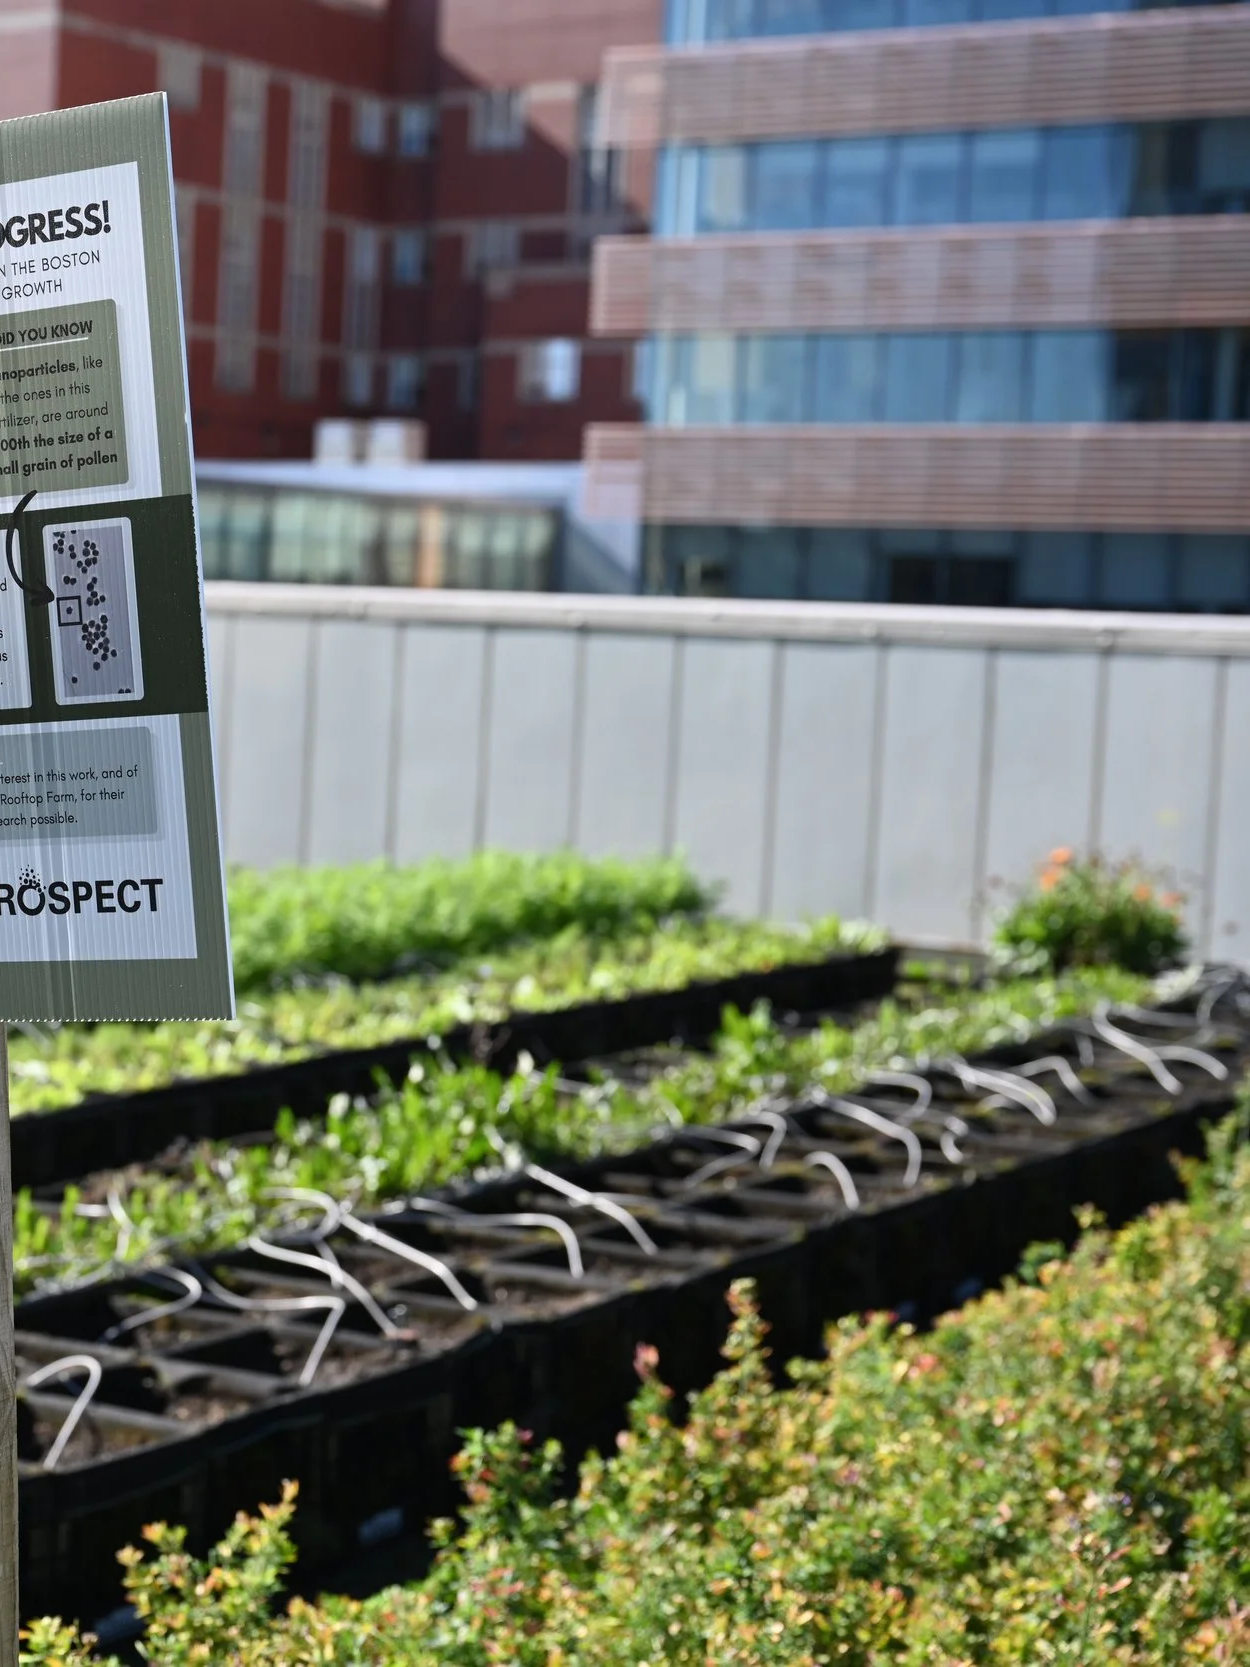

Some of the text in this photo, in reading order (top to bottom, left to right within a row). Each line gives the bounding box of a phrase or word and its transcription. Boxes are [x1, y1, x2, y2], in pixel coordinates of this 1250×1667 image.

[11, 260, 36, 276] THE
[41, 250, 101, 272] BOSTON
[1, 279, 63, 301] GROWTH
[19, 327, 47, 343] YOU
[51, 320, 93, 339] KNOW
[82, 356, 103, 371] like
[0, 382, 90, 405] the ones in this
[41, 411, 62, 423] are
[65, 401, 109, 420] around
[33, 434, 55, 448] the
[58, 429, 84, 445] size
[87, 428, 102, 442] of
[104, 429, 113, 439] a
[22, 458, 57, 478] grain
[60, 455, 74, 470] of
[77, 451, 118, 471] pollen
[34, 769, 44, 782] in
[47, 767, 66, 781] this
[69, 765, 99, 781] work,
[102, 764, 123, 778] and
[126, 764, 138, 776] of
[1, 791, 43, 807] Rooftop
[47, 787, 77, 803] Farm,
[80, 787, 96, 801] for
[99, 785, 125, 800] their
[30, 811, 78, 828] possible.
